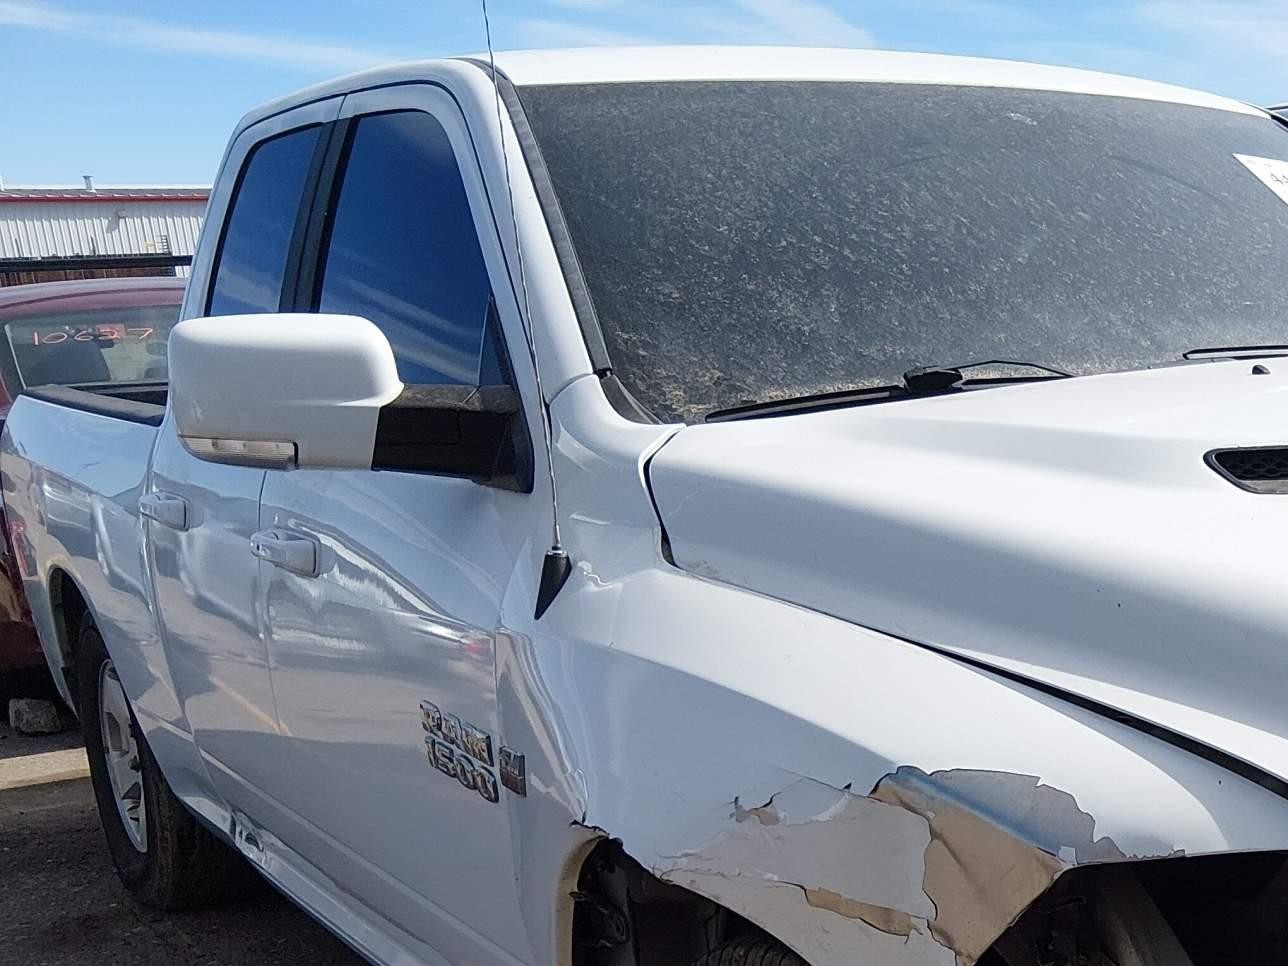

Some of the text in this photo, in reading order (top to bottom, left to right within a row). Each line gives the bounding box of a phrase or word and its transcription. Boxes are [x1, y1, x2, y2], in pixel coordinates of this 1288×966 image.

[33, 326, 154, 347] 10627
[419, 699, 495, 767] RAM
[425, 735, 499, 803] 1500
